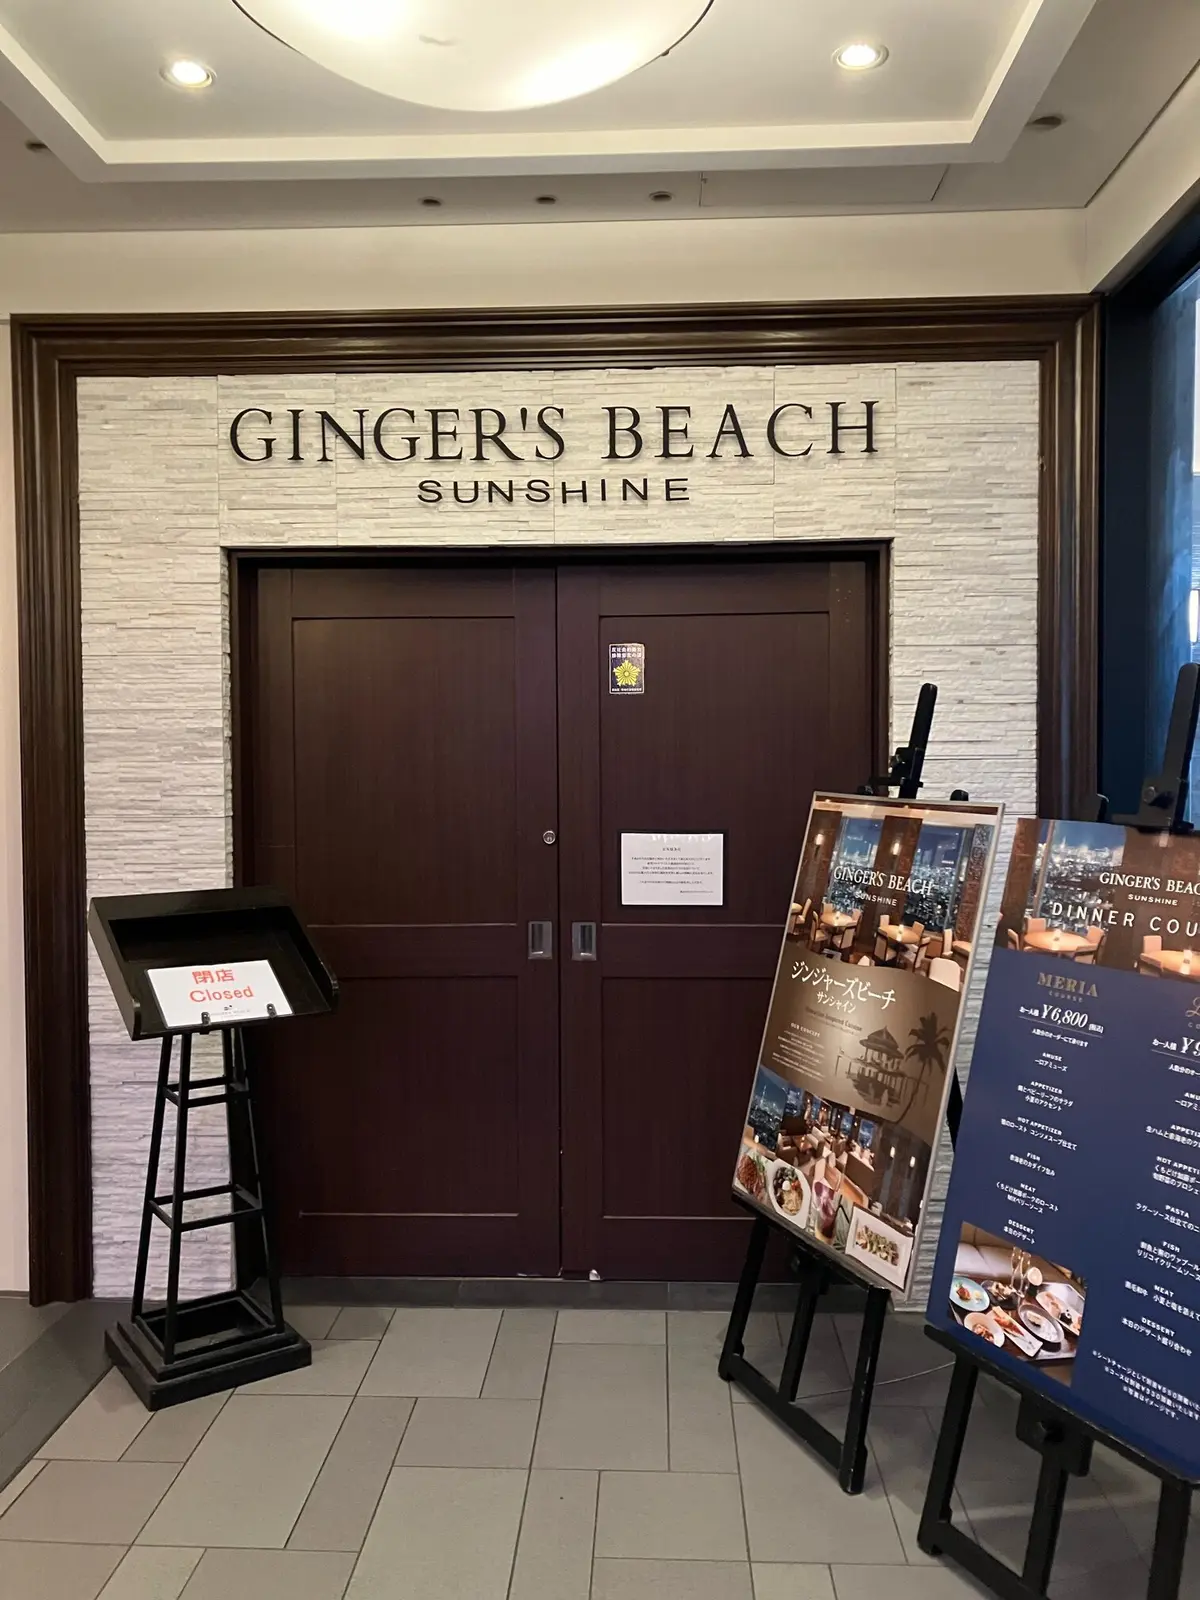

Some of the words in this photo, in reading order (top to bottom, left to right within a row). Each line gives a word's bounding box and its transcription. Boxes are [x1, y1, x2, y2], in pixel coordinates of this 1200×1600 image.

[229, 406, 565, 462] GINGER'S
[601, 400, 879, 459] BEACH
[417, 478, 690, 503] SUNSHINE
[834, 866, 886, 887] GINGER'S
[888, 874, 934, 896] BEACH
[1100, 872, 1161, 890] GINGER'S
[855, 891, 897, 906] SUNSHINE
[1128, 894, 1178, 906] SUNSHINE
[1052, 902, 1135, 927] DINNER
[1150, 916, 1198, 937] COU
[191, 968, 235, 985] 閉店
[791, 960, 896, 1010] ジンジャーズビーチ
[1037, 972, 1098, 998] MERIA
[189, 986, 254, 1003] Closed
[816, 991, 856, 1013] サンシャイン
[1048, 990, 1083, 1003] COURSE
[1041, 1004, 1088, 1028] ¥6,800
[1042, 1052, 1062, 1061] AMUSE
[1034, 1059, 1068, 1072] 一口アミューズ
[1030, 1081, 1063, 1094] APPETIZER
[1017, 1116, 1029, 1124] HOT
[1030, 1121, 1063, 1136] APPETIZER
[1026, 1152, 1041, 1161] FISH
[1156, 1156, 1172, 1165] HOT
[1020, 1183, 1036, 1193] MEAT
[1164, 1204, 1190, 1219] PASTA
[1003, 1225, 1035, 1245] 本日のデザート
[1008, 1219, 1035, 1234] DESSERT
[1162, 1241, 1180, 1253] FISH
[1153, 1284, 1174, 1297] MEAT
[1141, 1316, 1175, 1337] DESSERT
[1121, 1317, 1192, 1356] 本日のデザート盛り合わせ
